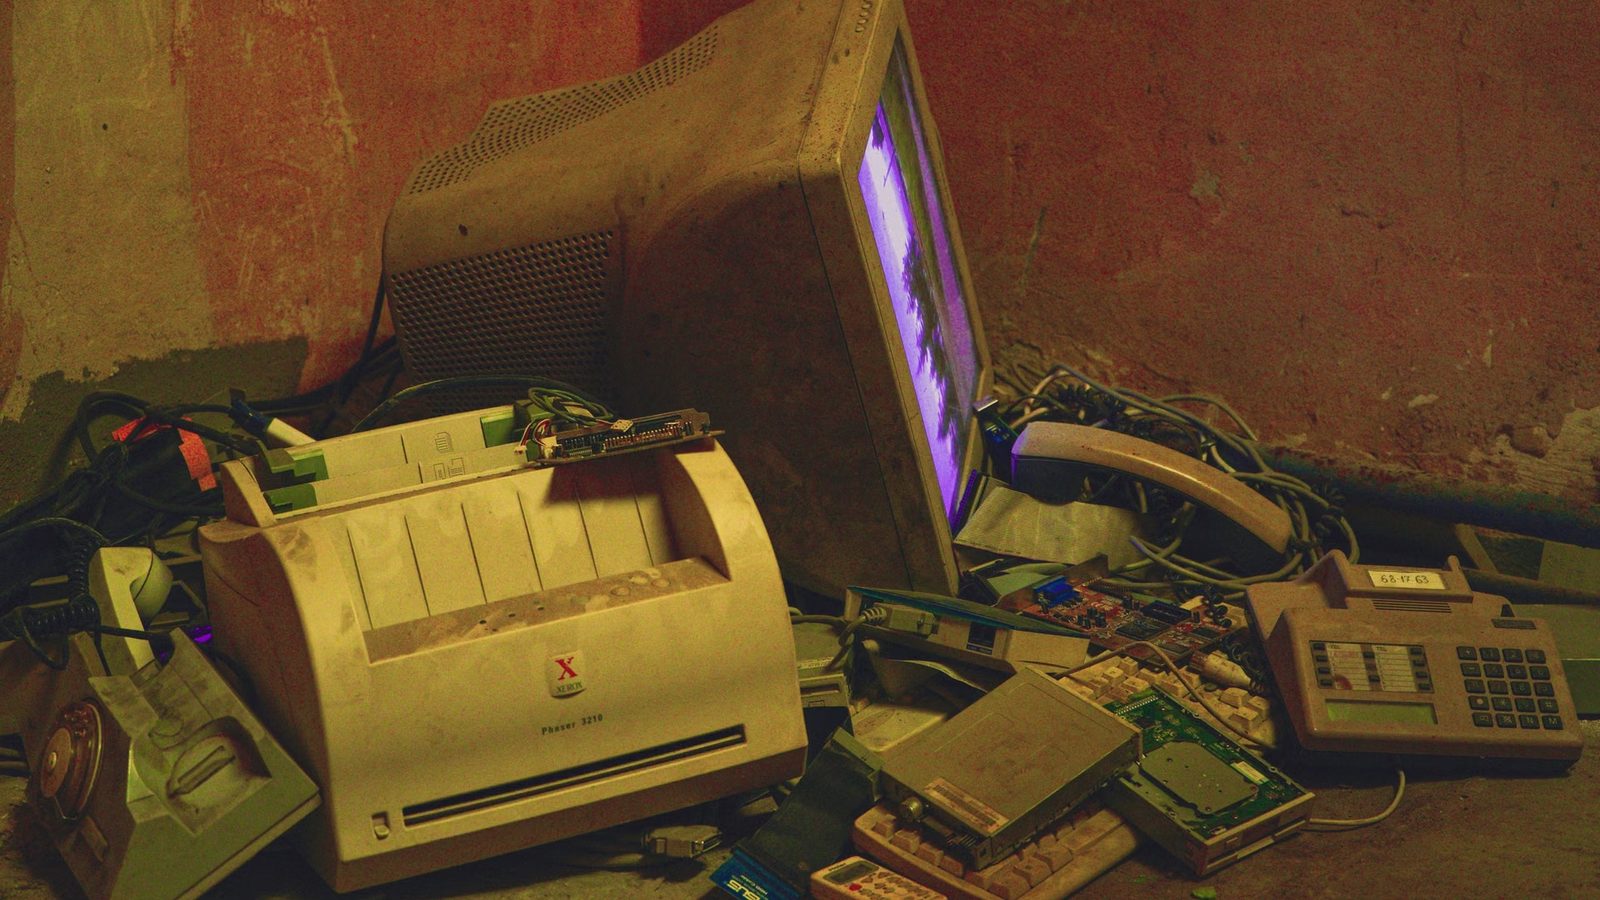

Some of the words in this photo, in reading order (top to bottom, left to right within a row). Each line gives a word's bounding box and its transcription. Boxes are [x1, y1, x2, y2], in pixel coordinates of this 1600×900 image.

[554, 656, 578, 681] X
[541, 721, 576, 735] Phaser
[581, 713, 604, 726] 3210
